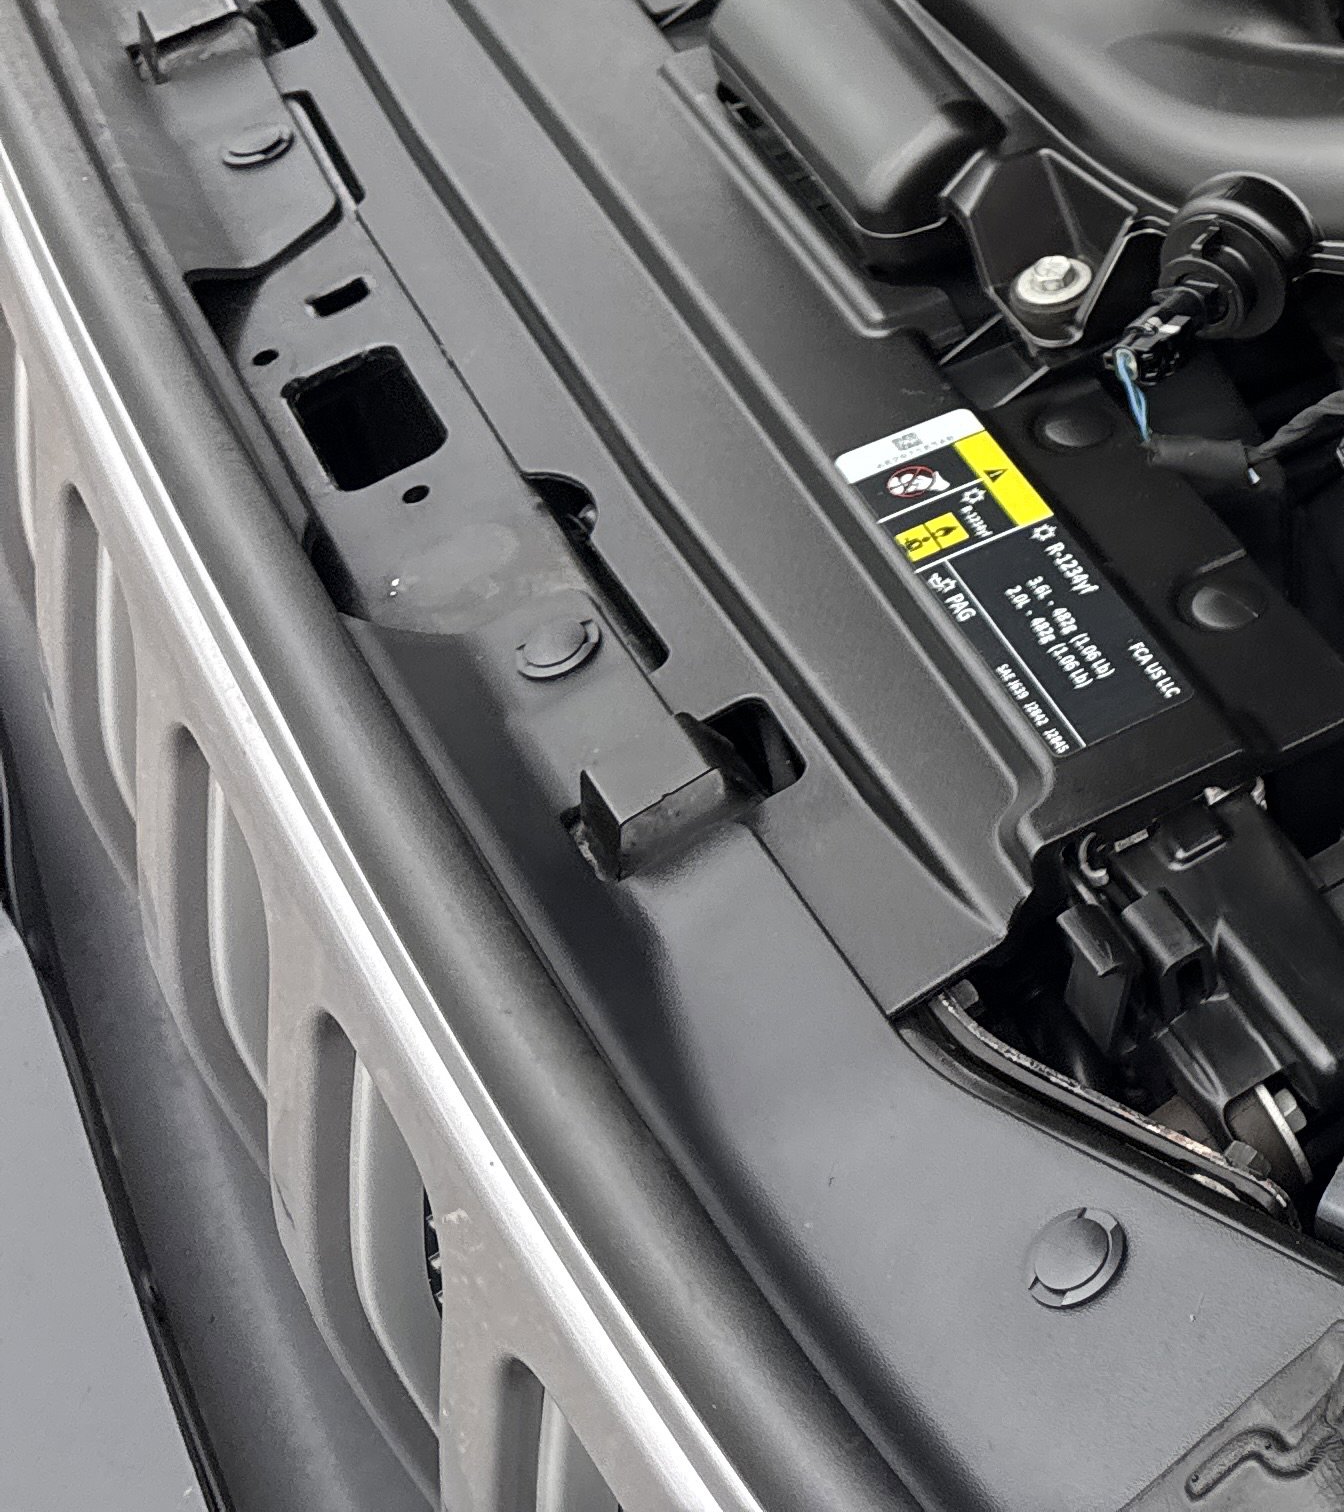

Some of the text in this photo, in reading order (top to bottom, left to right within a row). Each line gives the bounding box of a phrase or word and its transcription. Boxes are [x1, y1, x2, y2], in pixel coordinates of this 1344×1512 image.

[1044, 541, 1100, 595] R-1234yf
[1026, 576, 1053, 600] 3.6L
[943, 593, 977, 622] PAG
[995, 663, 1017, 682] SAE
[1127, 641, 1182, 699] FCA US LLC
